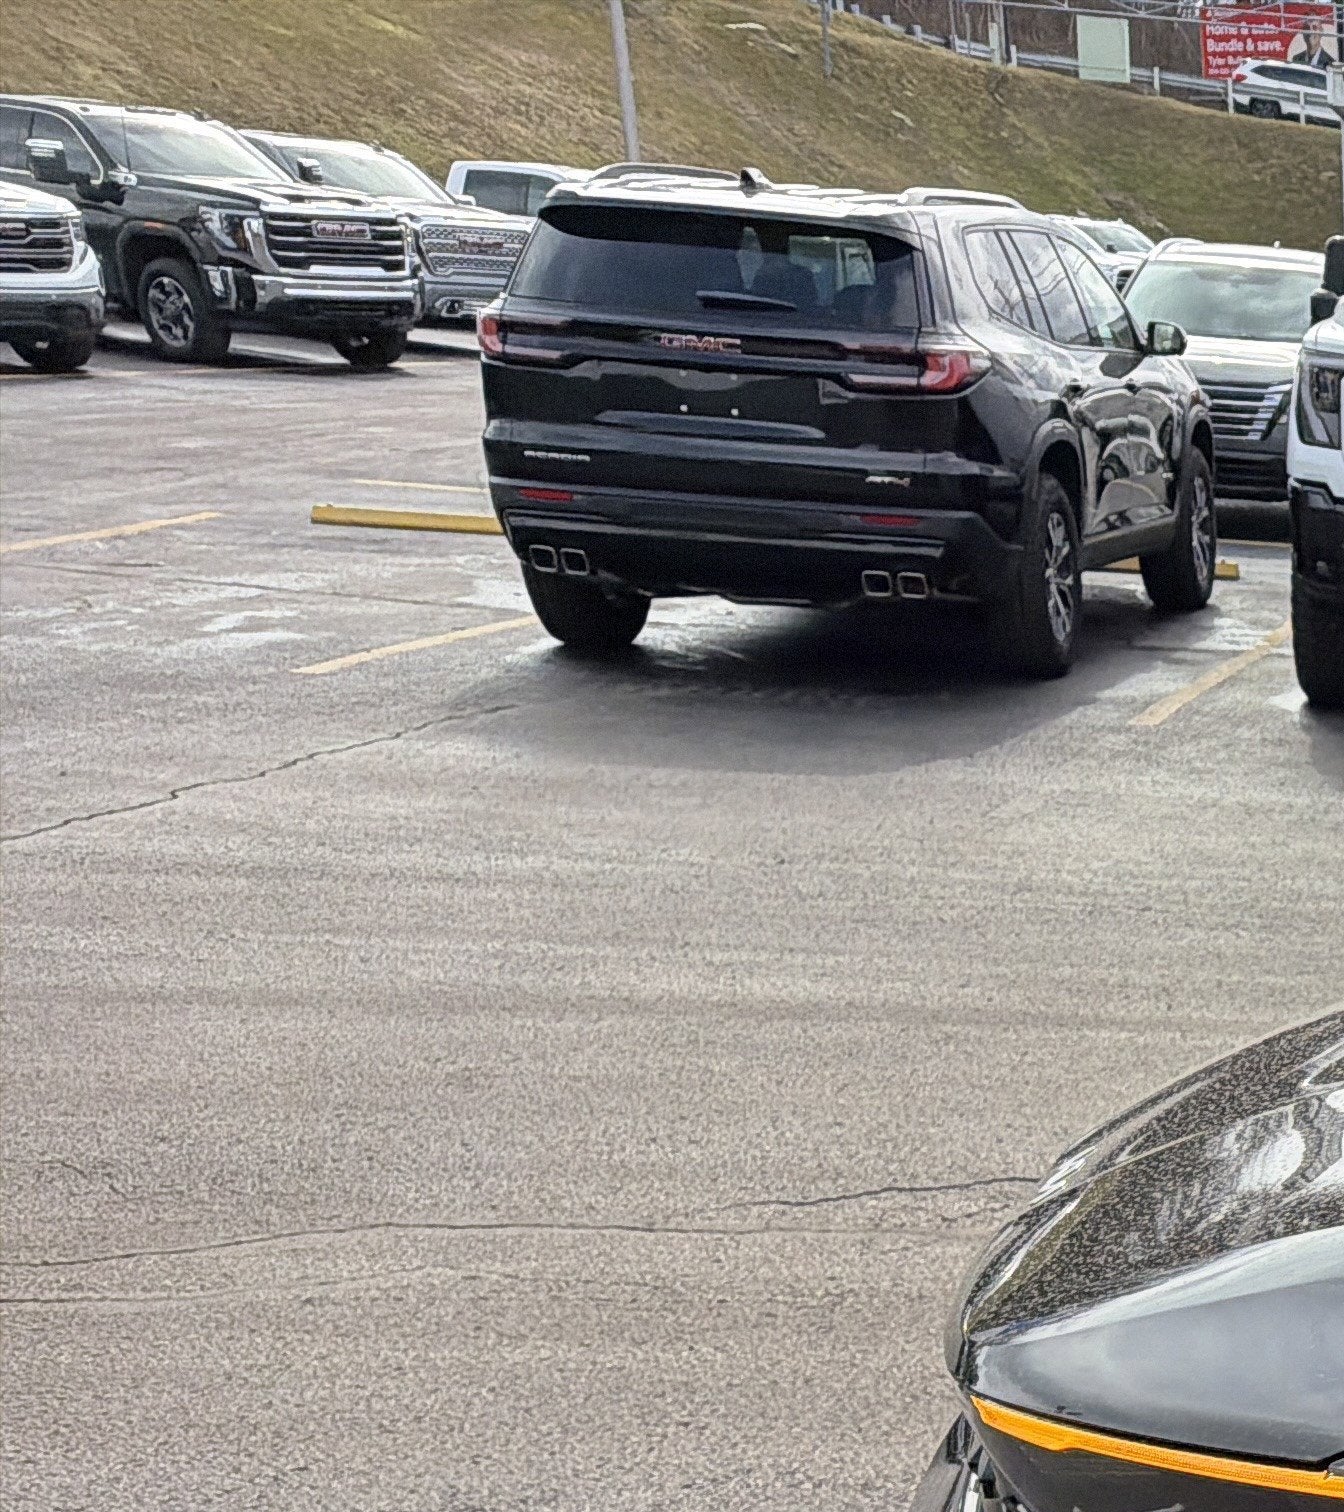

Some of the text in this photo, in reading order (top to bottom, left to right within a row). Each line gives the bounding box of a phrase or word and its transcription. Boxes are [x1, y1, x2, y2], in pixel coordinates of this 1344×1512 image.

[1206, 38, 1285, 52] Bundle & save.
[660, 333, 741, 354] GMC
